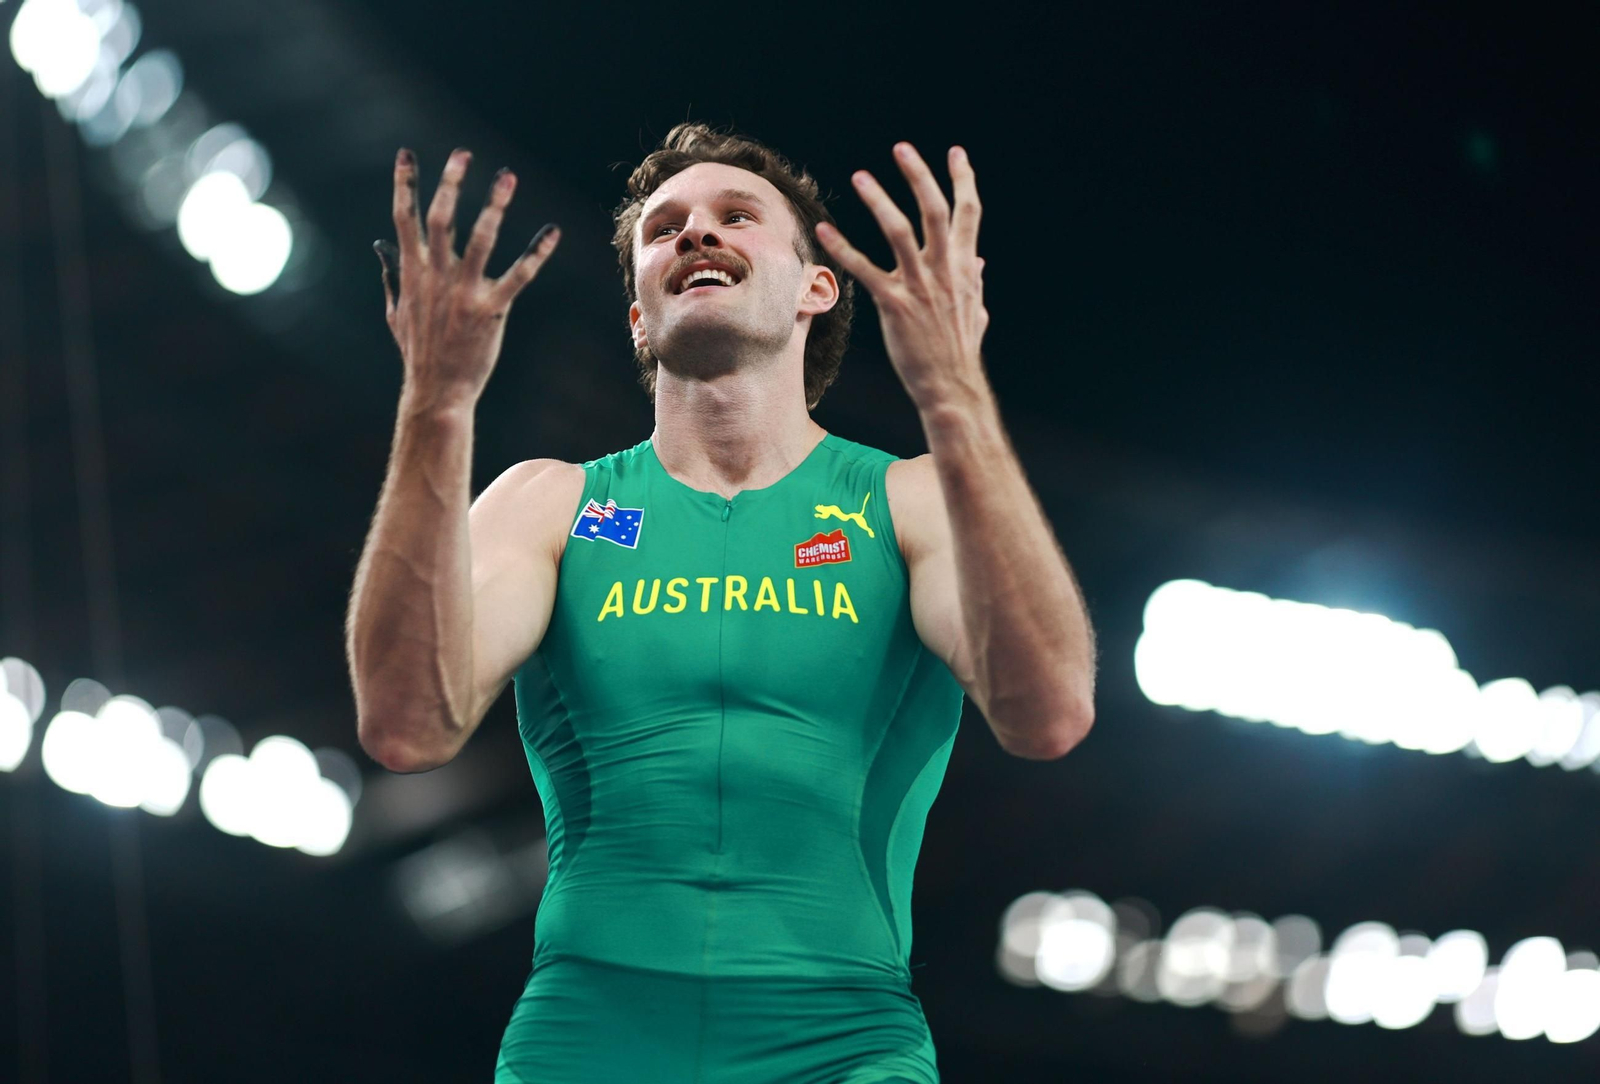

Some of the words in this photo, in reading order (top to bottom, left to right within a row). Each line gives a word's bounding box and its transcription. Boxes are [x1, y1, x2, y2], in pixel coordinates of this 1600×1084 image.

[798, 540, 846, 558] CHEMIST
[798, 552, 846, 564] WAREHOUSE
[597, 575, 860, 624] AUSTRALIA
